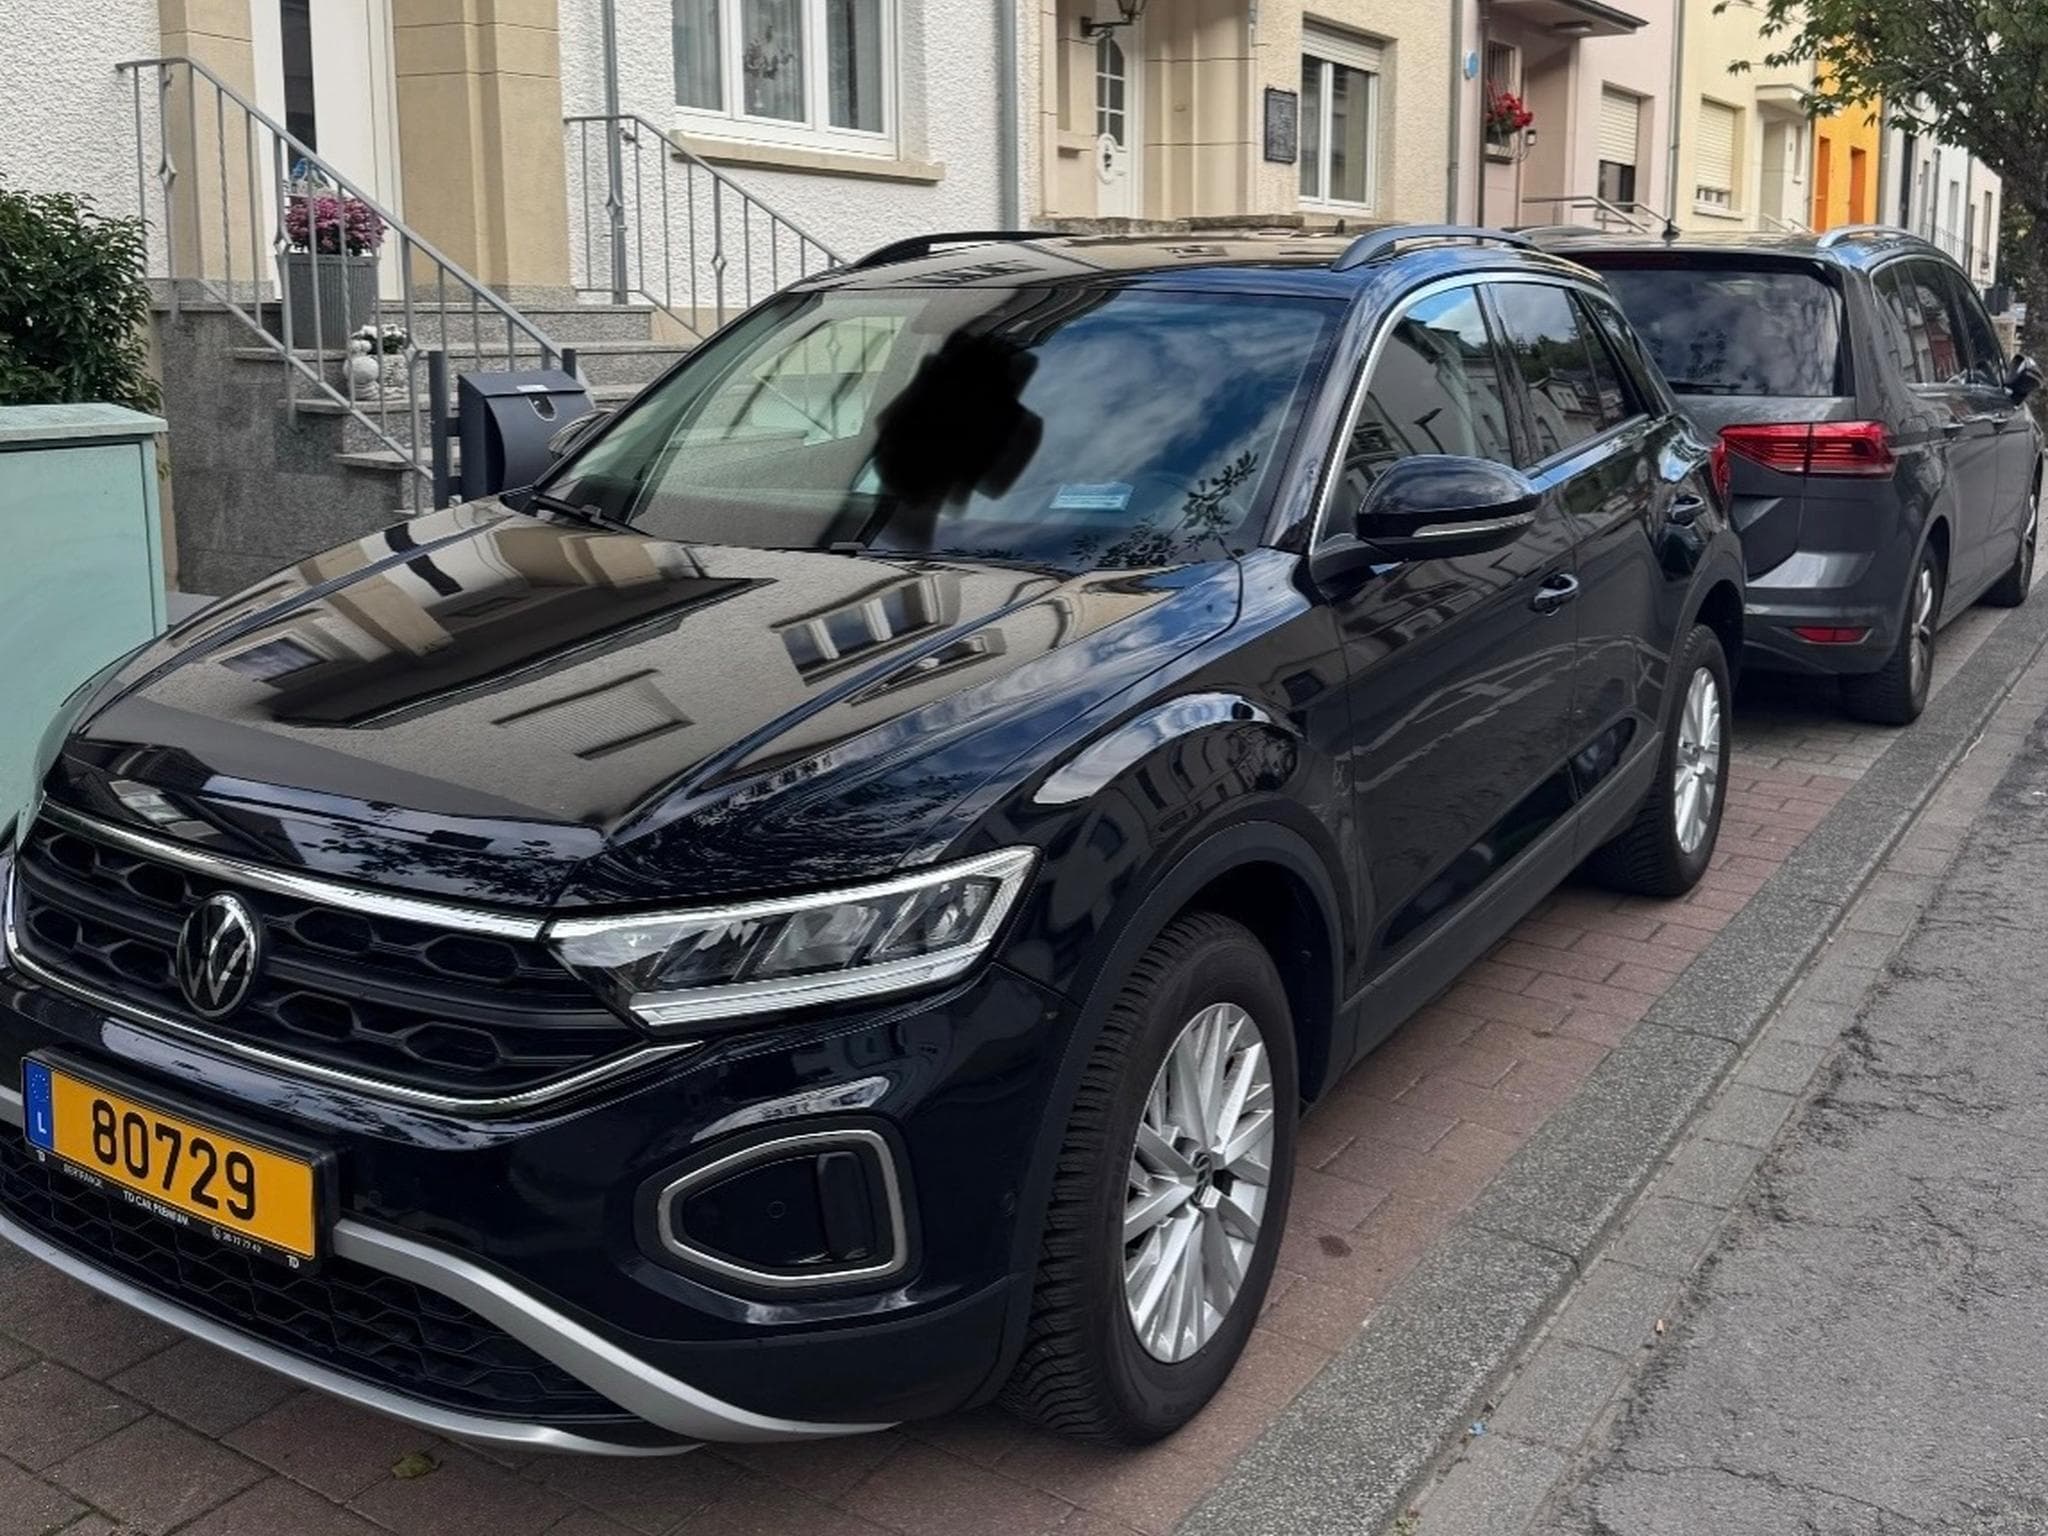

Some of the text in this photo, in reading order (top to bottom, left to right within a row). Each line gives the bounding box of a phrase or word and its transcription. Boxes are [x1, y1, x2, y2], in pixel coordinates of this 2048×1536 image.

[37, 1111, 47, 1134] L
[92, 1099, 255, 1220] 80729
[285, 1255, 300, 1269] TD
